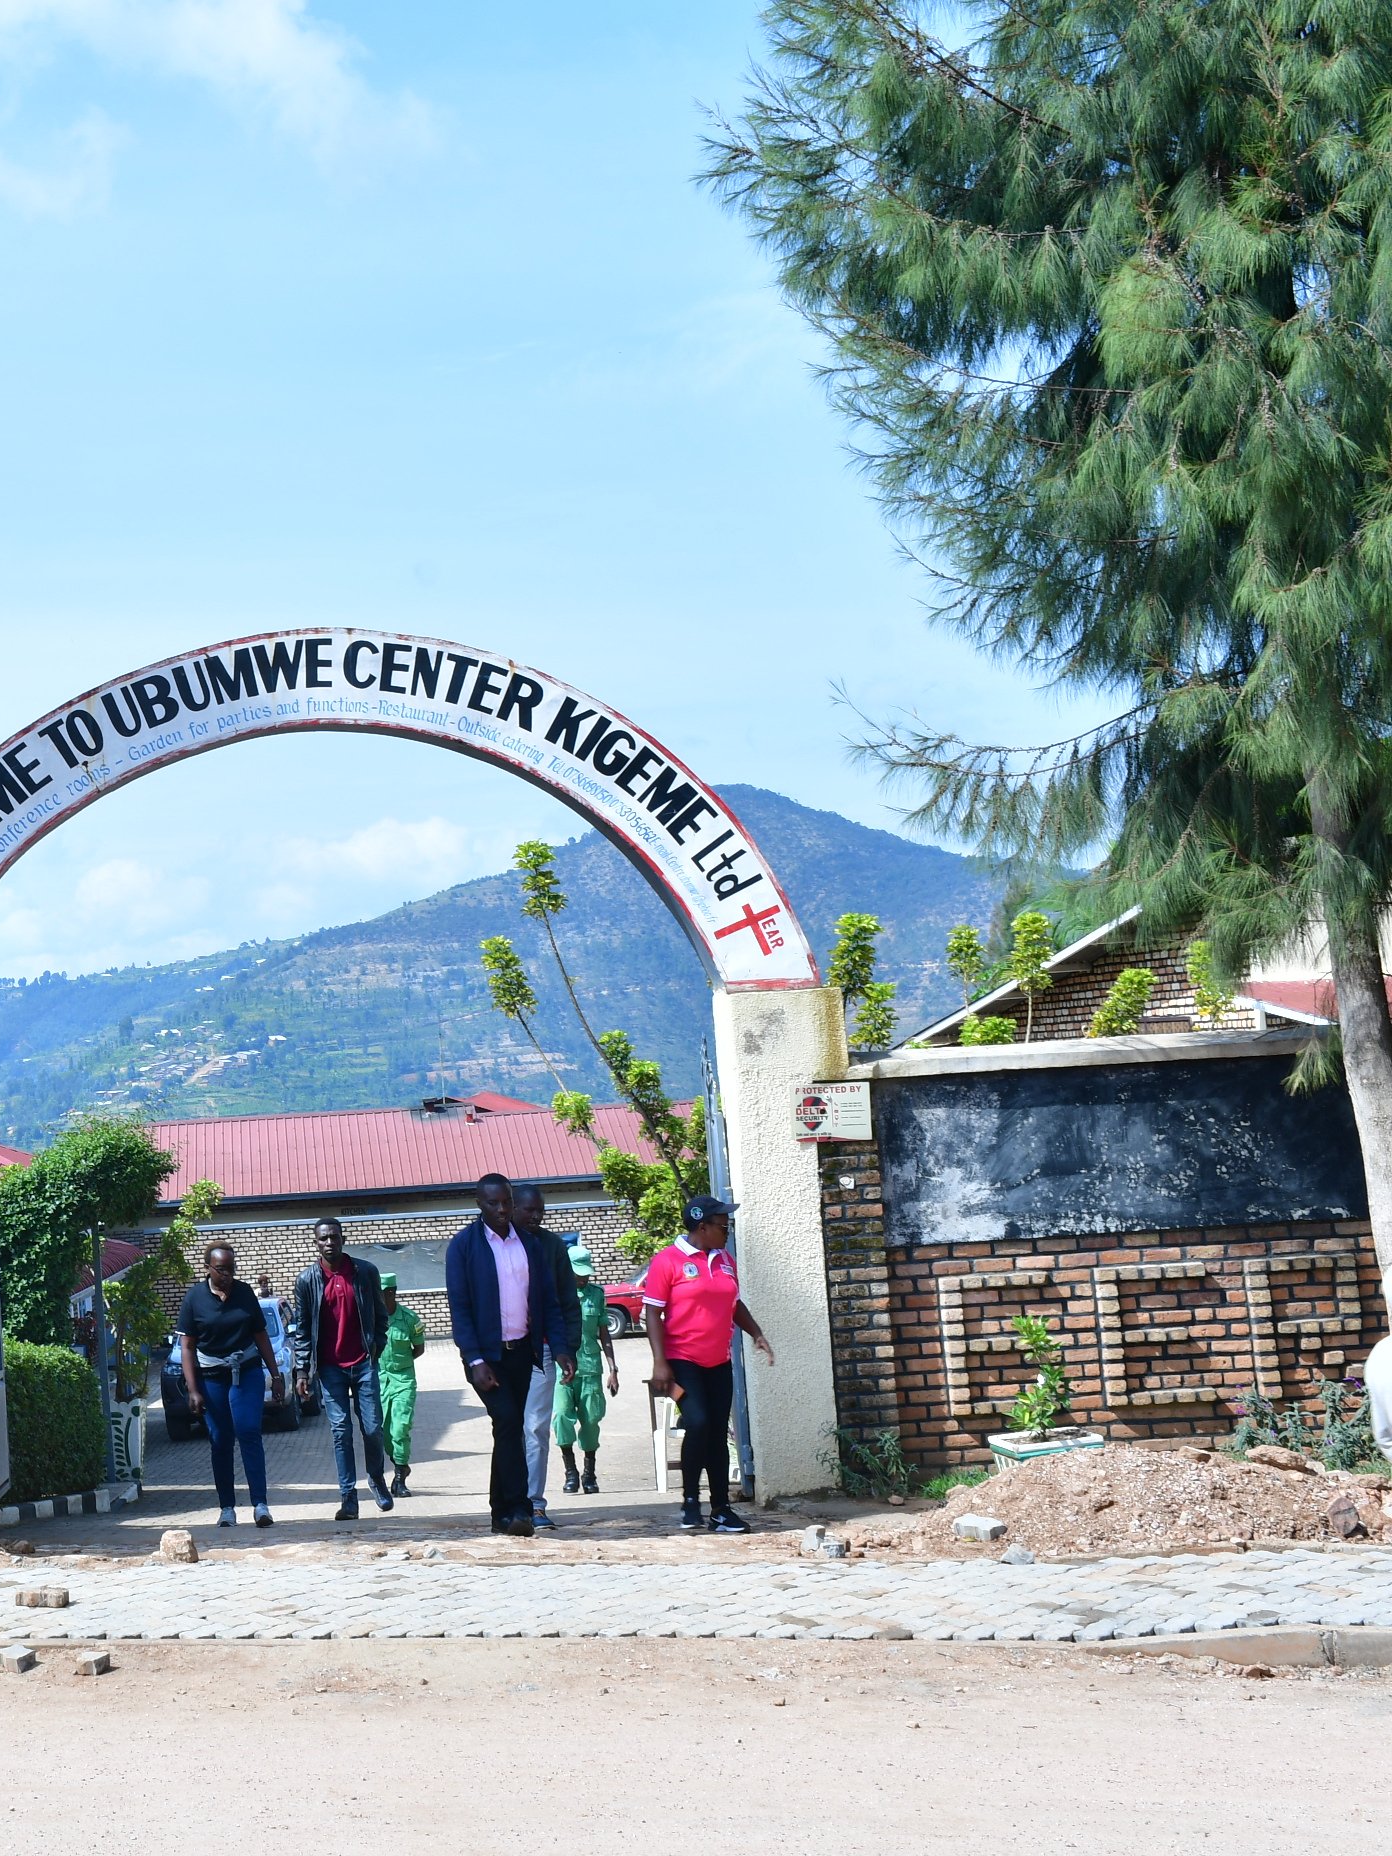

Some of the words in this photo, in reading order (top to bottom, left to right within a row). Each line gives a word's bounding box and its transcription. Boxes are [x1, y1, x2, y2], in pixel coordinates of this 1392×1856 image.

[38, 709, 104, 769] TO
[100, 638, 333, 737] UBUMWE
[343, 639, 544, 732] CENTER
[544, 695, 719, 847] KIGEME
[691, 828, 764, 902] Ltd
[65, 764, 111, 797] rooms
[128, 731, 184, 761] Garden
[188, 720, 210, 740] for
[216, 703, 272, 733] parties
[276, 697, 300, 716] and
[502, 735, 546, 764] catering
[761, 917, 785, 949] EAR
[795, 1086, 847, 1095] PROTECTED
[849, 1085, 862, 1093] BY
